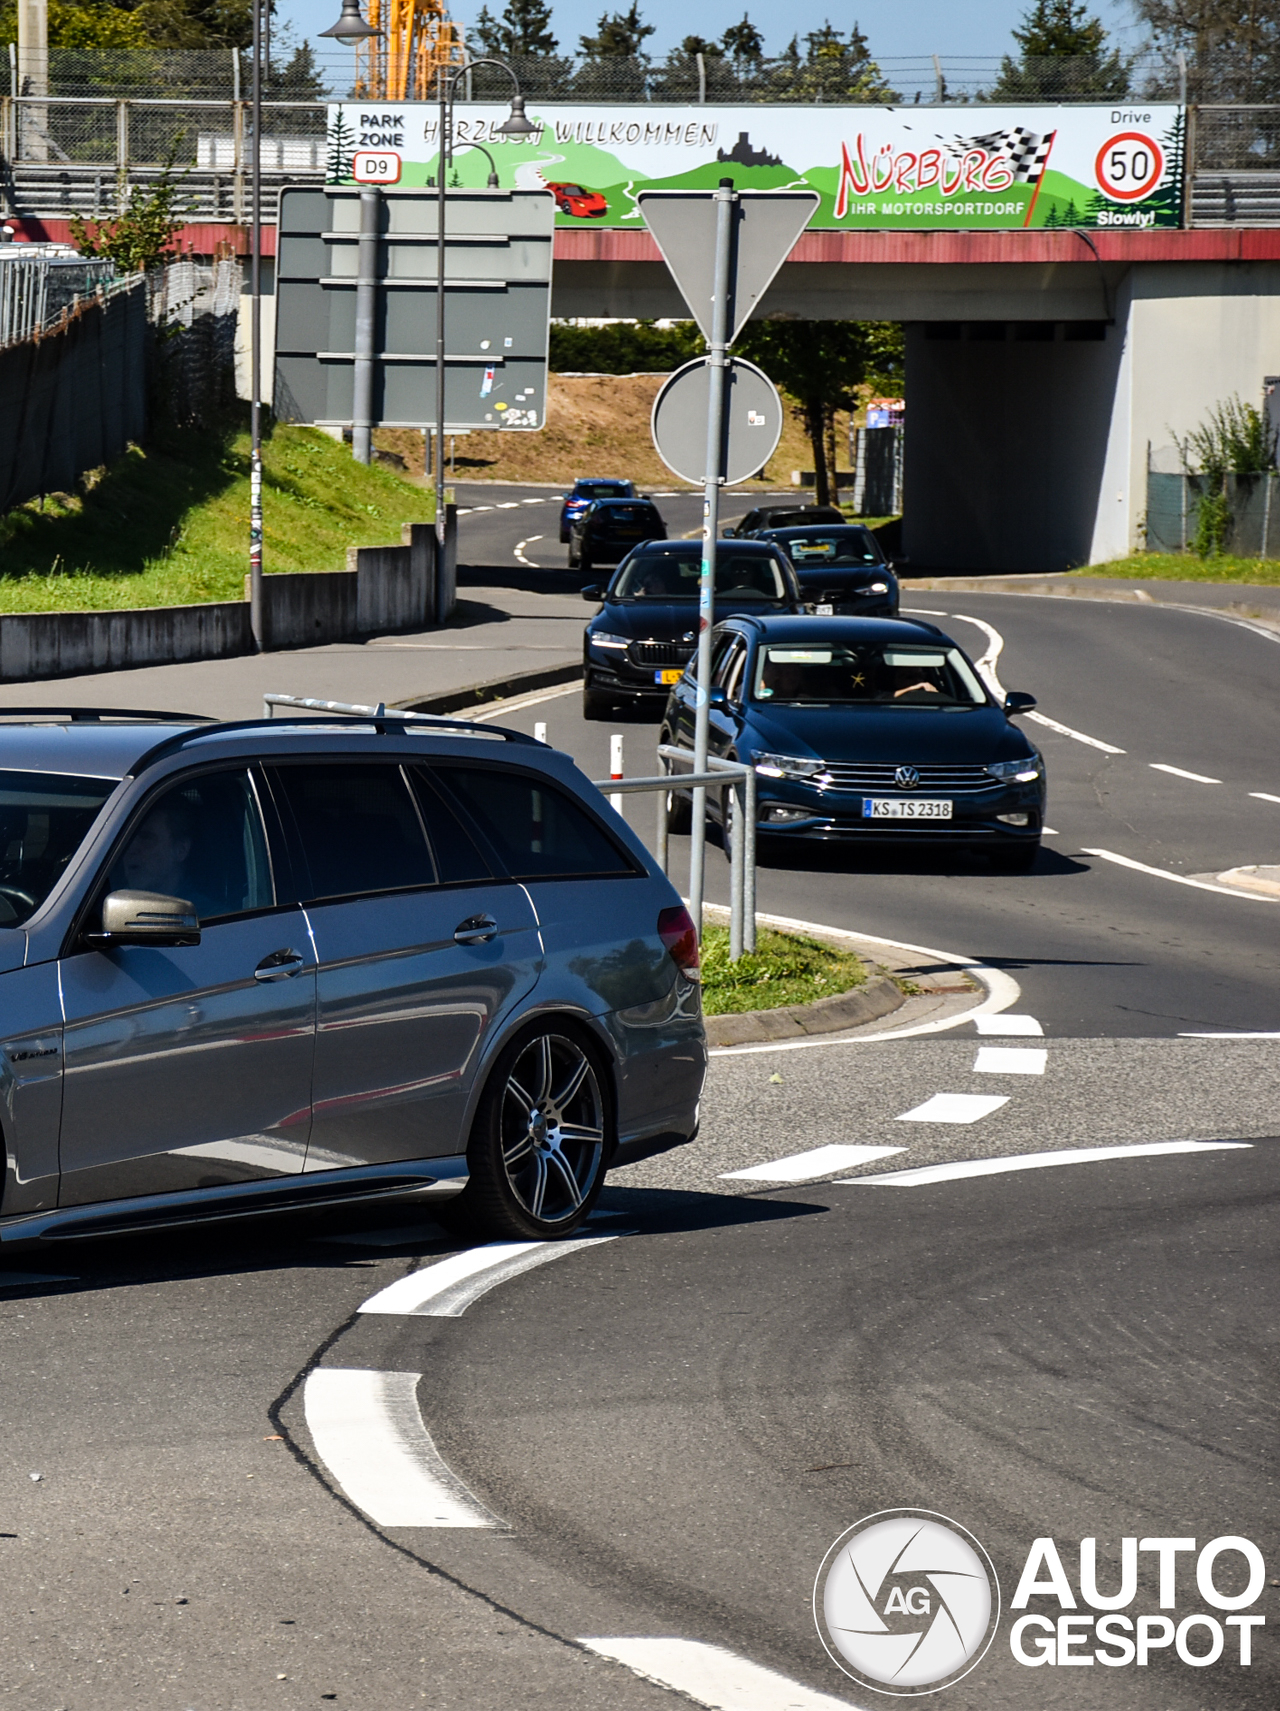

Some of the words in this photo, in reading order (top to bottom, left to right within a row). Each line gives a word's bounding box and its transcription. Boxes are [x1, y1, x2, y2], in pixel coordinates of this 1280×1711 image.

[360, 114, 405, 129] PARK
[1111, 110, 1152, 124] Drive
[358, 132, 404, 148] ZONE
[555, 120, 718, 145] WILLKOMMEN
[365, 159, 388, 174] D9
[1110, 151, 1148, 181] 50
[834, 132, 1013, 219] NÜRBURG
[851, 202, 877, 215] IHR
[881, 202, 1025, 215] MOTORSPORTDORF
[1097, 210, 1155, 228] Slowly!
[873, 802, 890, 816] KS
[899, 802, 915, 816] TS
[918, 803, 950, 817] 2318
